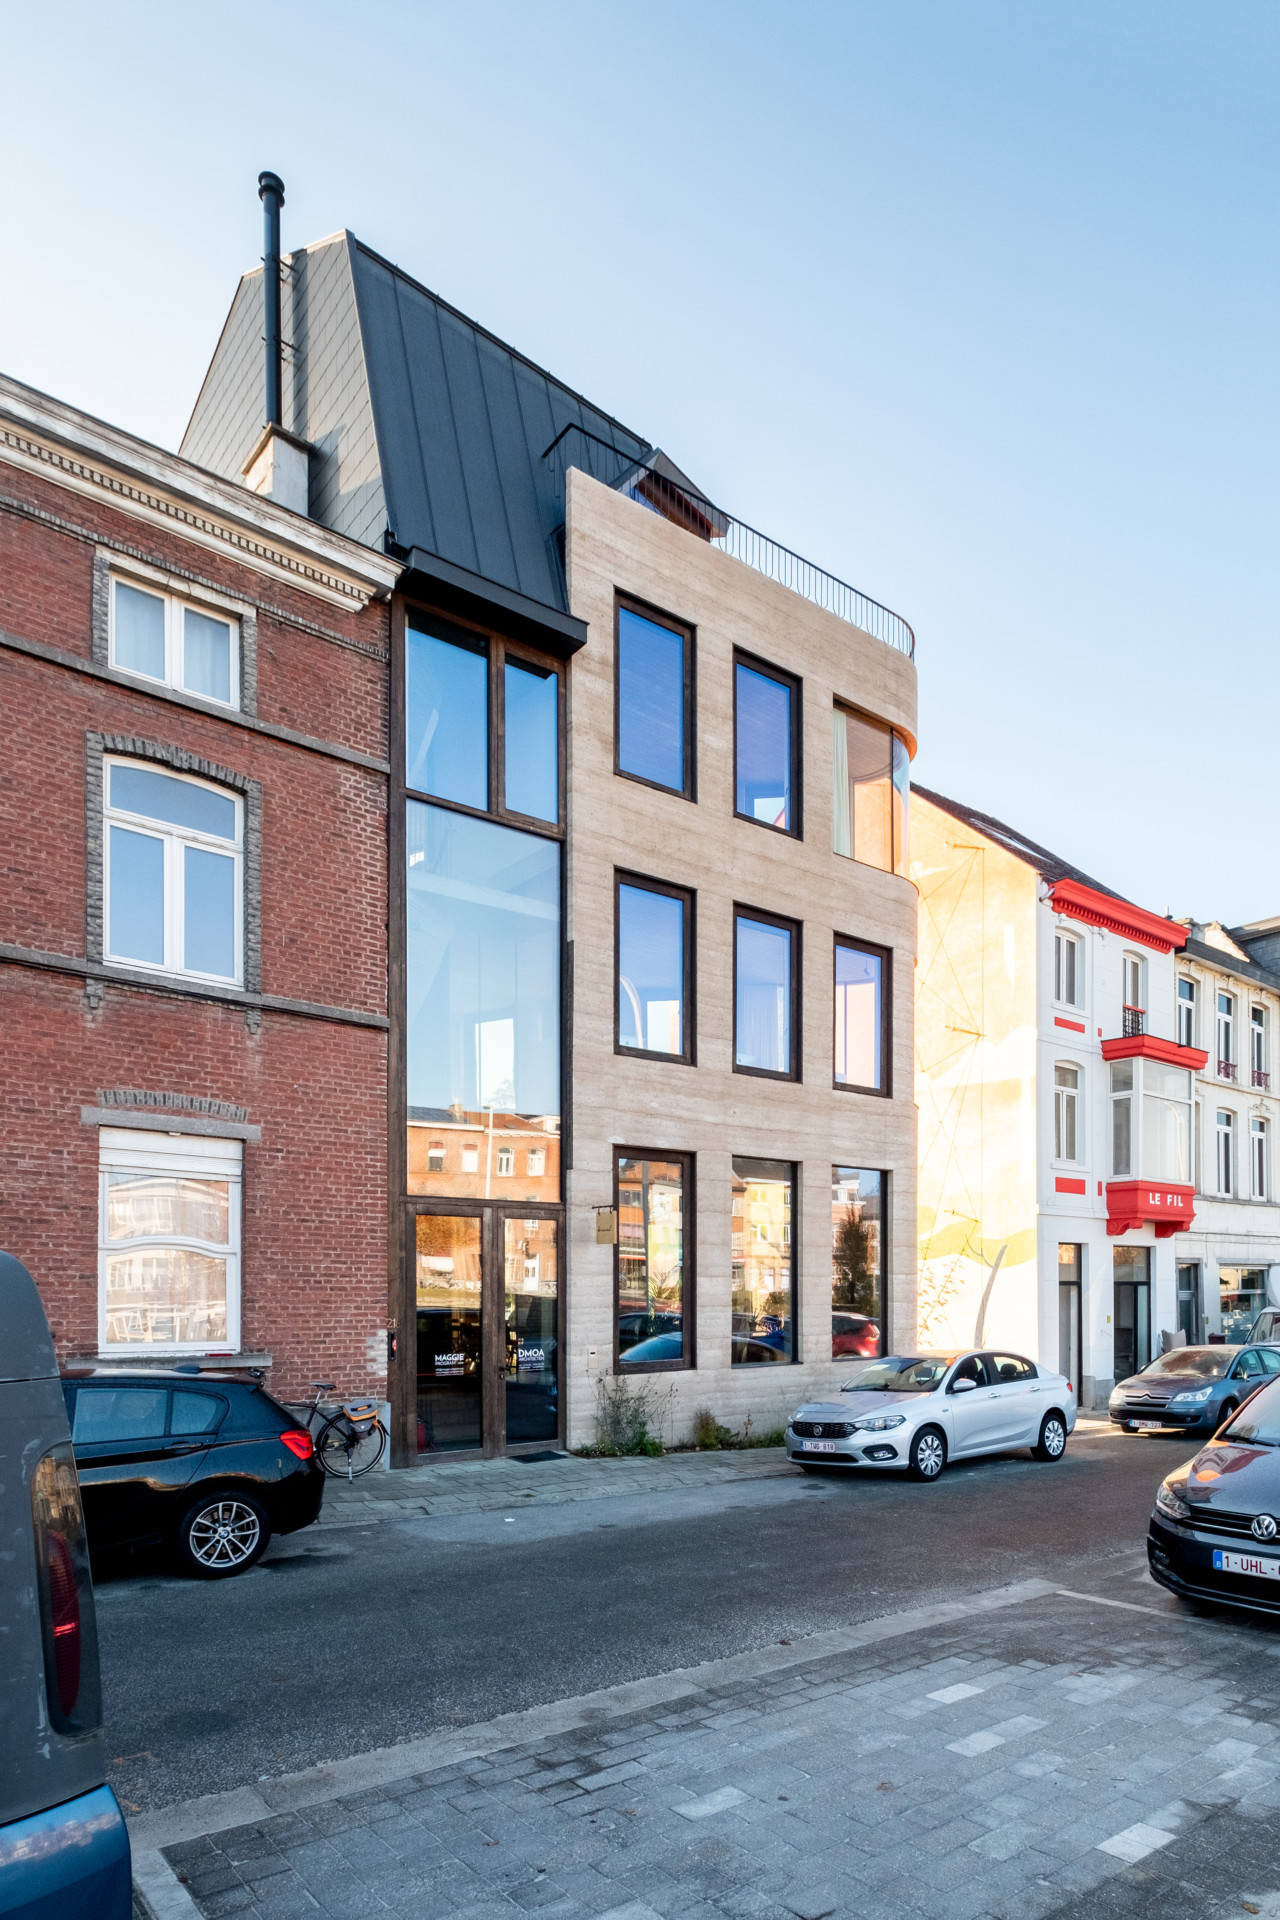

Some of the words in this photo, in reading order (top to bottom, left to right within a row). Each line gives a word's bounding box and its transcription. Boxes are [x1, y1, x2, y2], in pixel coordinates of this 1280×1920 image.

[1149, 1192, 1161, 1205] LE
[1167, 1194, 1184, 1207] FIL
[434, 1353, 465, 1361] MAGGIE
[518, 1348, 545, 1357] DMOA
[1225, 1555, 1280, 1576] 1-UHL-
